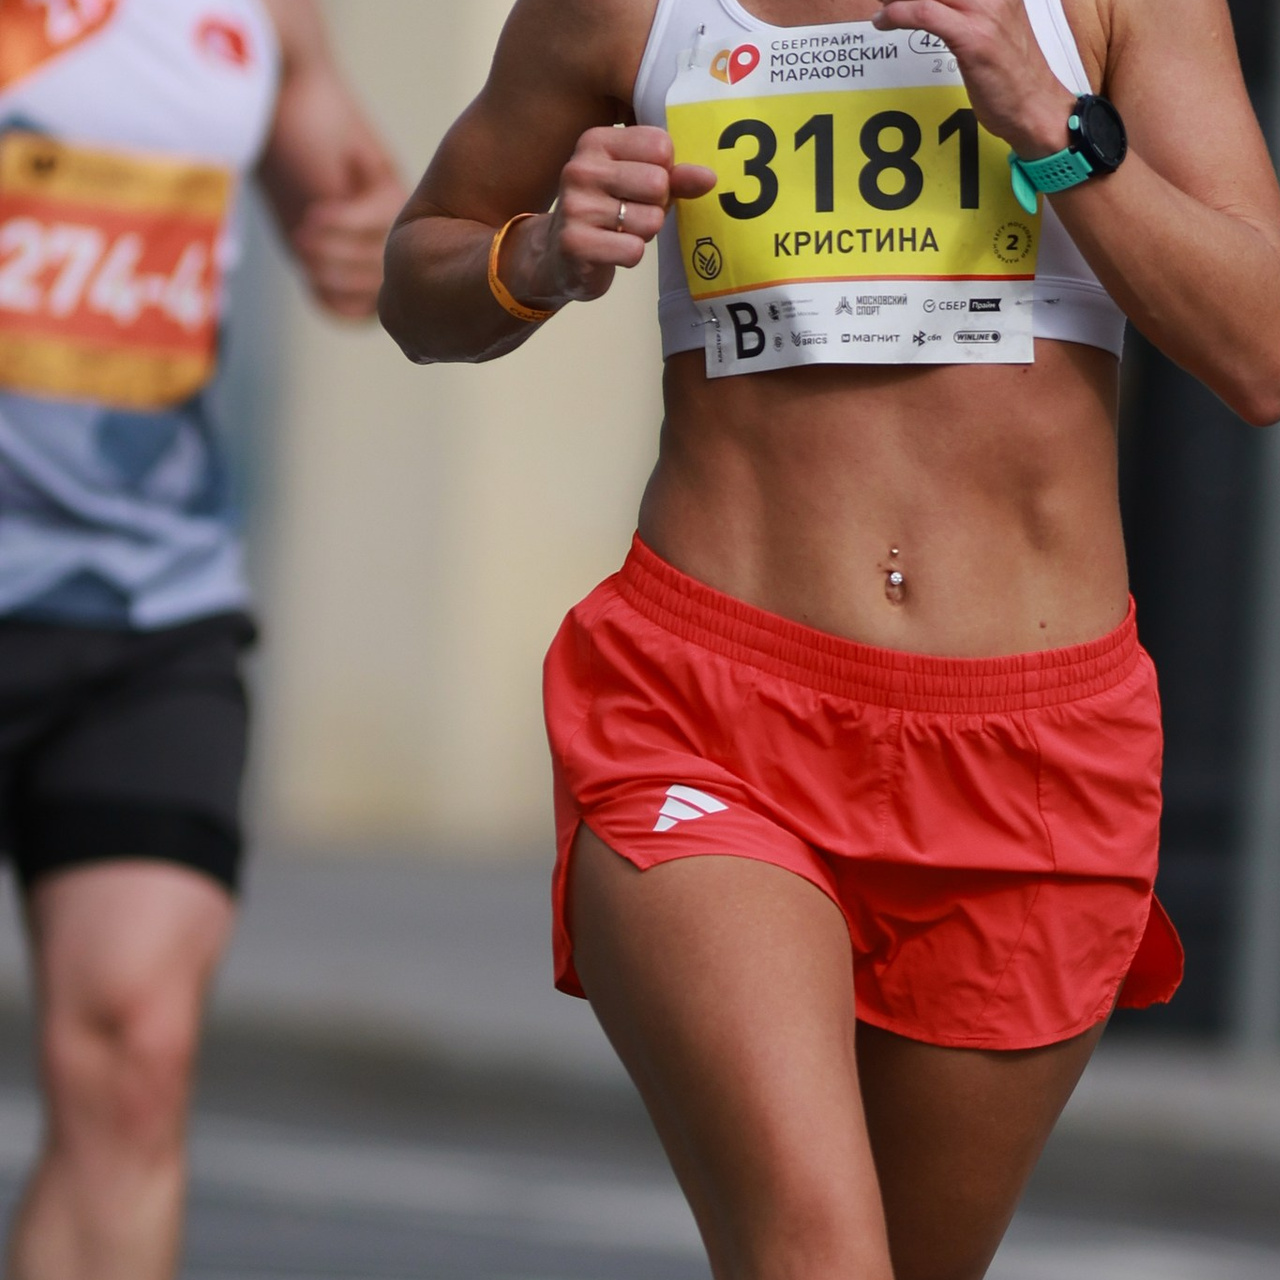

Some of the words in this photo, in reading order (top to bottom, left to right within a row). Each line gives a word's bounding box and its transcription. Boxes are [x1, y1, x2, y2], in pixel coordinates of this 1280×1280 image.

[771, 34, 864, 50] СБЕРПРАЙМ
[771, 43, 898, 66] МОСКОВСКИЙ
[771, 65, 864, 82] МАРАФОН
[717, 108, 980, 220] 3181
[773, 226, 940, 258] КРИСТИНА
[1006, 234, 1018, 250] 2
[856, 293, 908, 306] МОСКОВСКИЙ
[939, 301, 967, 310] СБЕР
[856, 305, 881, 316] СПОРТ
[802, 336, 828, 346] BRICS
[957, 333, 990, 341] WINLINE
